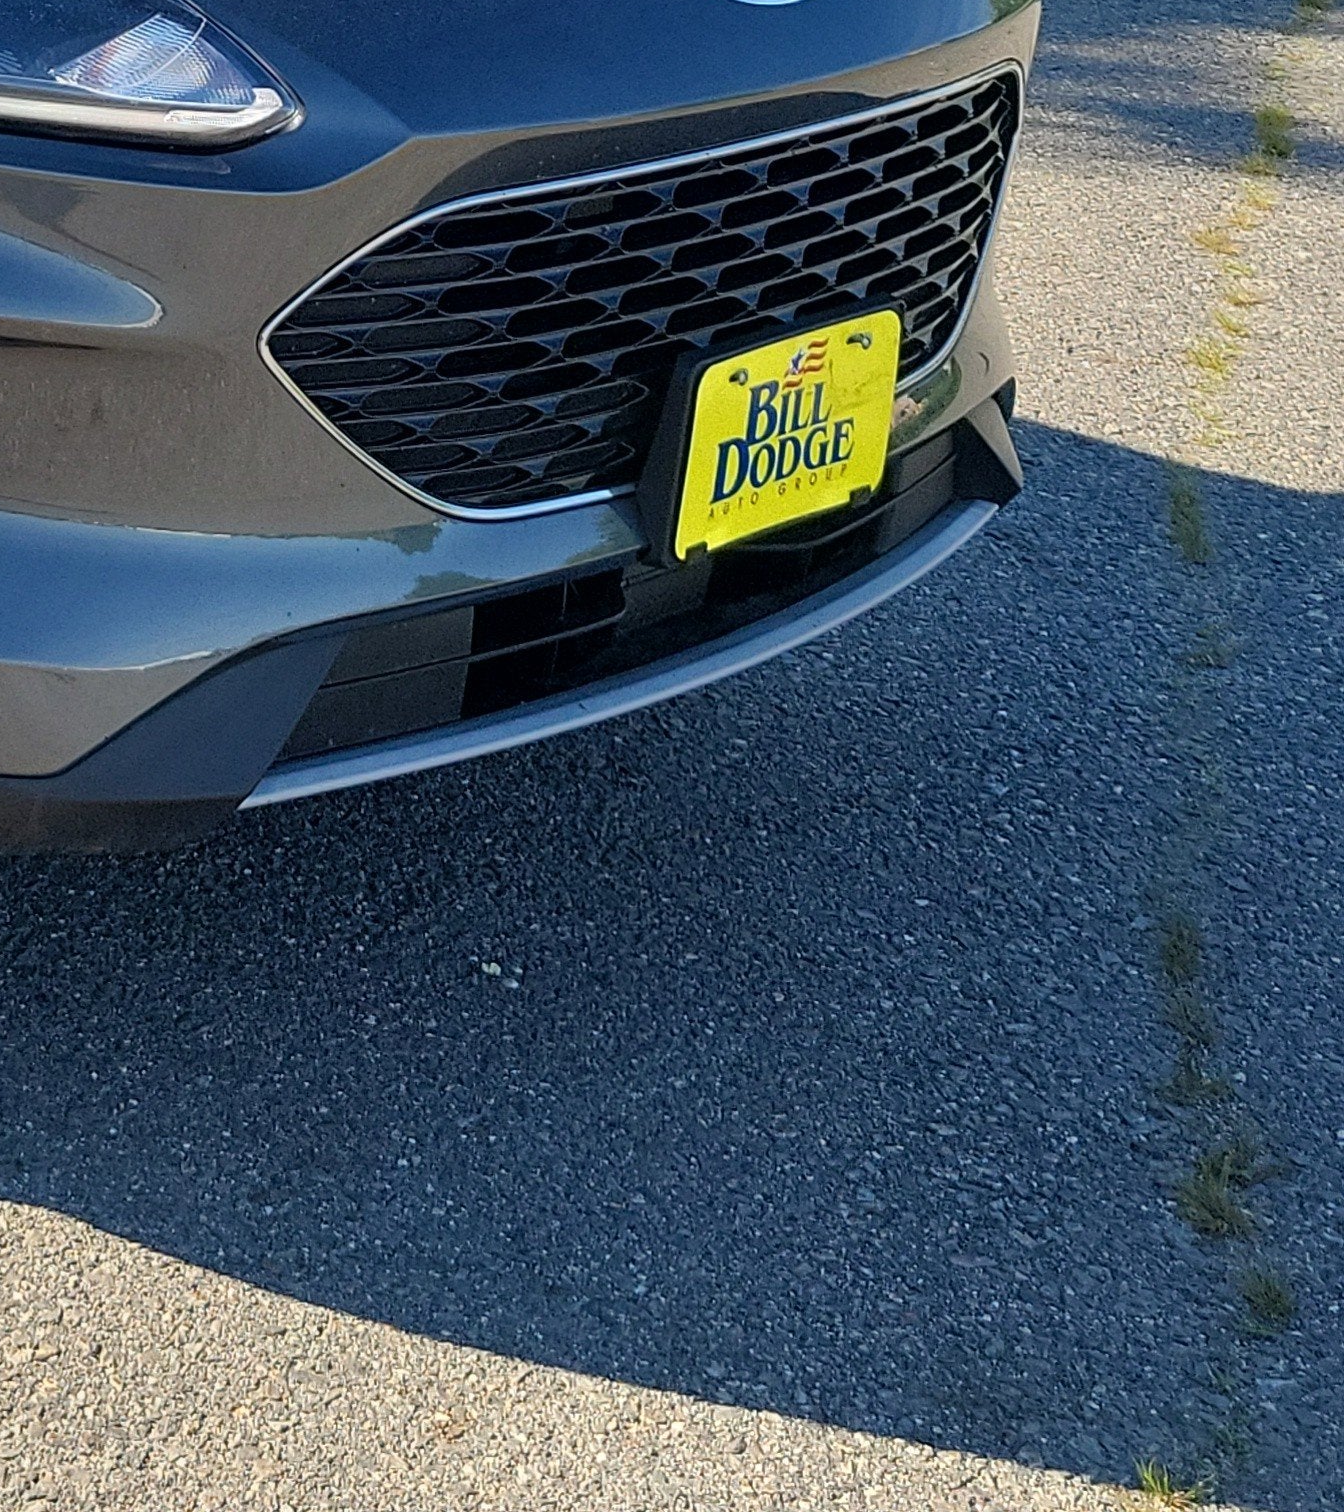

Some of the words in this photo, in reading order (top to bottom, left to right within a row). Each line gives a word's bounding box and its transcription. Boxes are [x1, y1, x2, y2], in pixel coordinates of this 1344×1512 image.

[746, 380, 833, 445] BILL
[709, 418, 855, 504] DODGE
[709, 492, 759, 519] AUTO
[778, 462, 848, 496] GROUP
